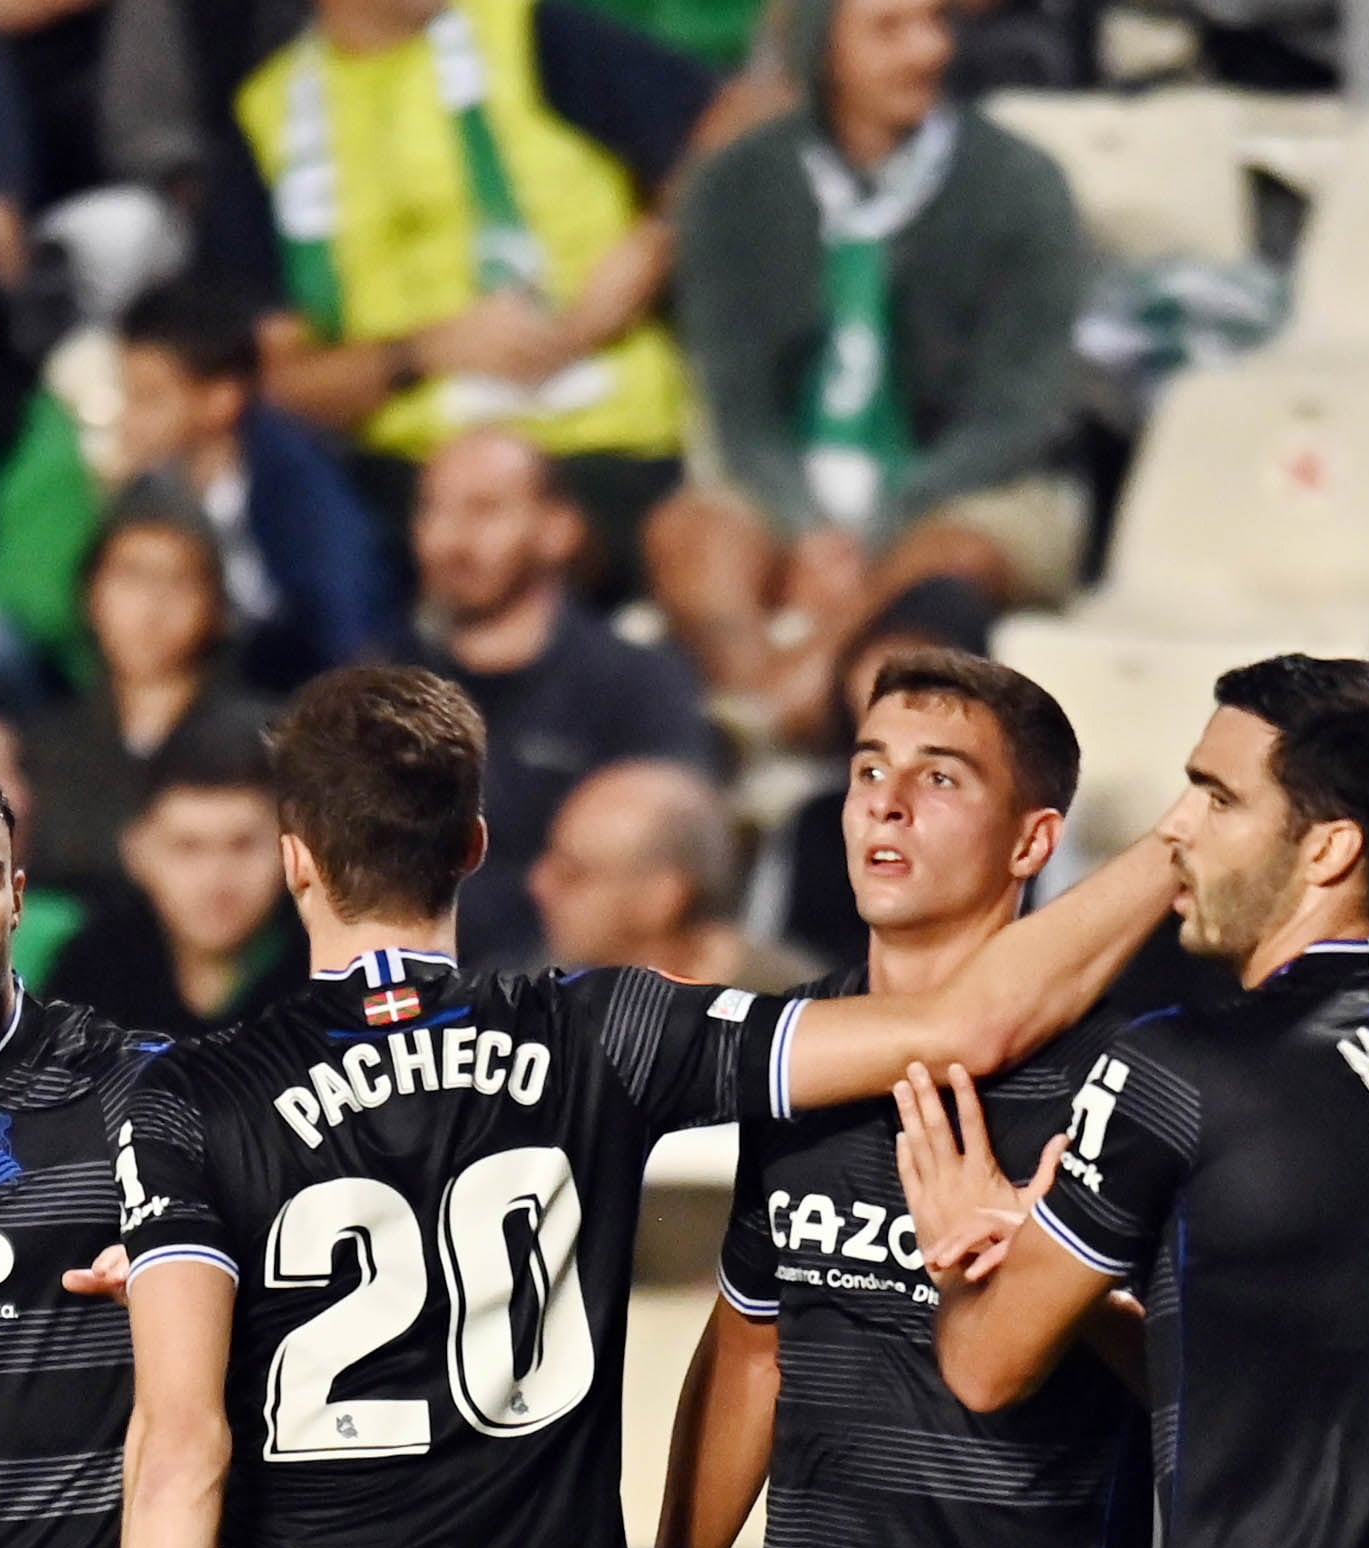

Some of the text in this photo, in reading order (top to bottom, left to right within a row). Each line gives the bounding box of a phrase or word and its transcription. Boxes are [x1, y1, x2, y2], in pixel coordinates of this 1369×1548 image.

[273, 1026, 551, 1150] PACHECO
[768, 1189, 928, 1271] CAZO
[262, 1146, 596, 1462] 20
